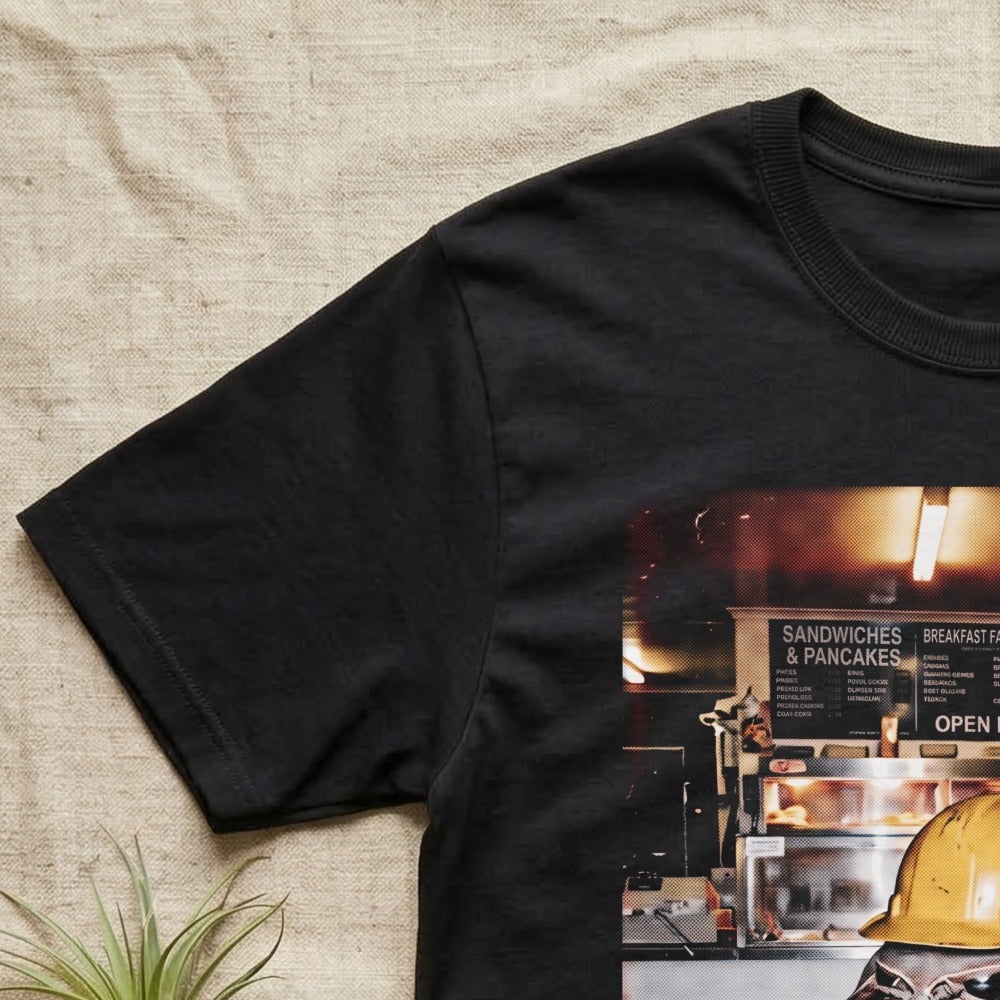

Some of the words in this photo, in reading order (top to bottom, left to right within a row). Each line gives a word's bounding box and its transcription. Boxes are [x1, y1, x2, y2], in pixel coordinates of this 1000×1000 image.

[782, 624, 902, 645] SANDWICHES
[923, 628, 987, 644] BREAKFAST
[786, 646, 799, 665] &
[804, 647, 902, 667] PANCAKES
[934, 714, 991, 733] OPEN
